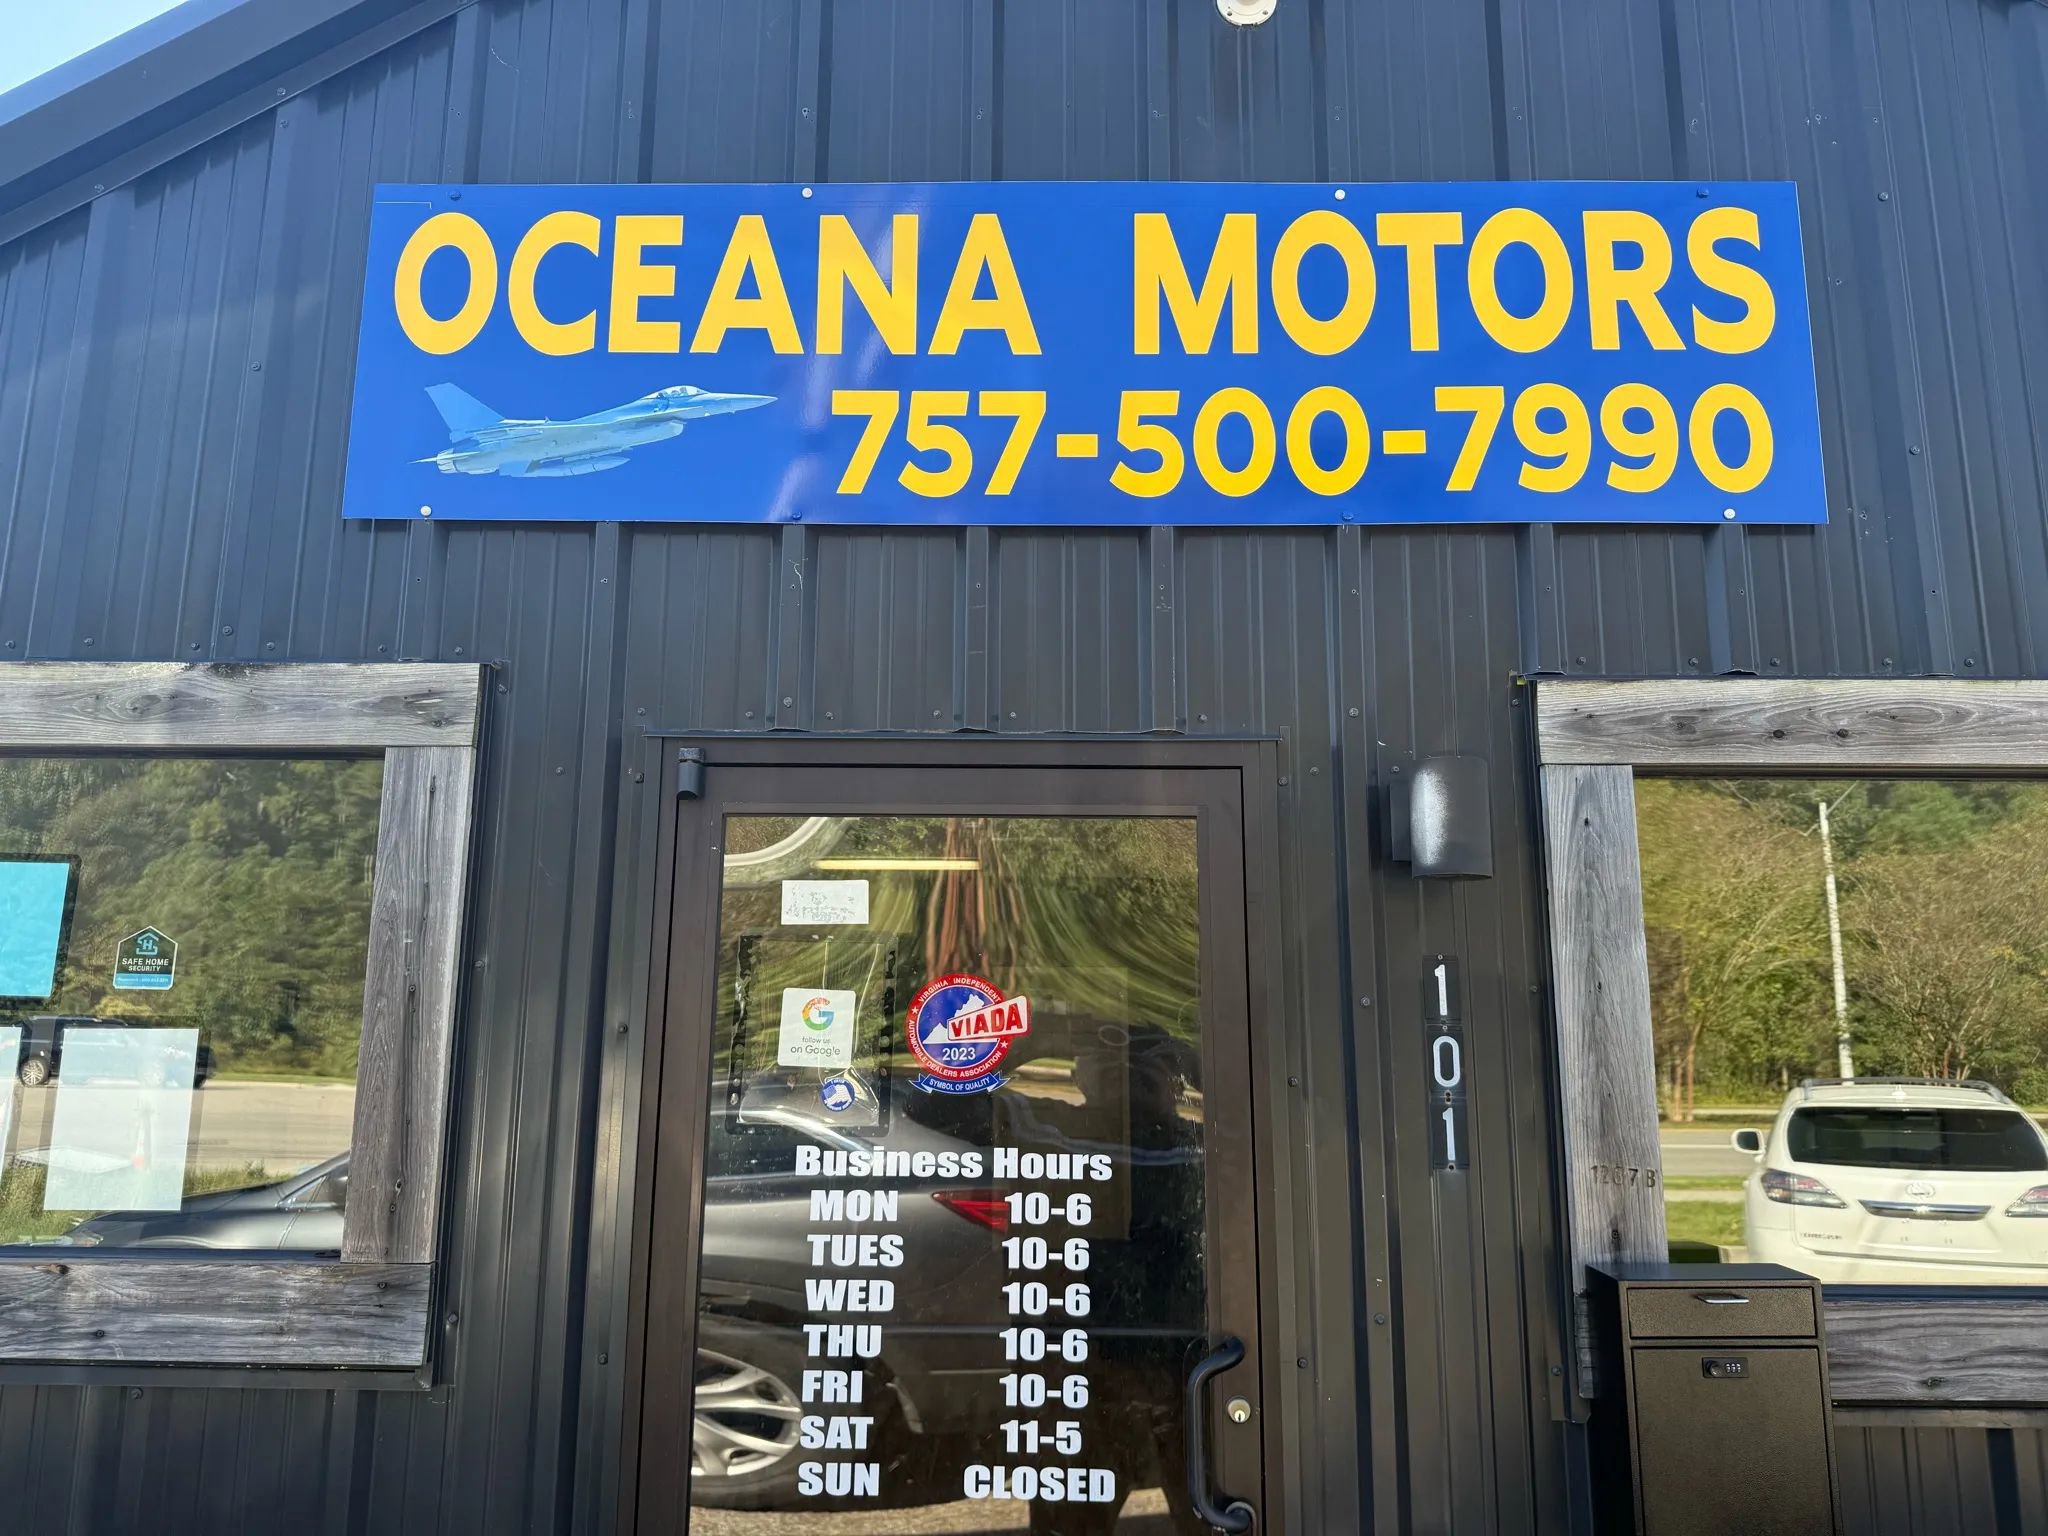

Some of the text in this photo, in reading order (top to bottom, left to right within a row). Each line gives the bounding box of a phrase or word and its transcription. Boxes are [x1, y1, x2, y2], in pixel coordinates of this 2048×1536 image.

[394, 206, 1776, 356] OCEANA MOTORS
[831, 382, 1774, 498] 757-500-7990
[122, 957, 169, 966] SAFE HOME
[918, 977, 1002, 1003] VIRGINIA INDEPENDENT
[951, 1002, 1023, 1038] VIADA
[790, 1045, 841, 1057] on Google
[802, 1036, 821, 1044] follow
[908, 1019, 1002, 1078] AUTOMOBILE DEALERS ASSOCIATION
[942, 1047, 976, 1061] 2023
[929, 1077, 990, 1091] SYMBOL OF QUALITY
[795, 1145, 1113, 1181] Business Hours
[810, 1190, 1092, 1226] MON 10-6
[807, 1234, 1090, 1271] TUES 10-6
[805, 1279, 1091, 1317] WED 10-6
[803, 1324, 1089, 1363] THU 10-6
[801, 1370, 1089, 1409] FRI 10-6
[800, 1415, 1082, 1455] SAT 11-5
[798, 1462, 1116, 1502] SUN CLOSED
